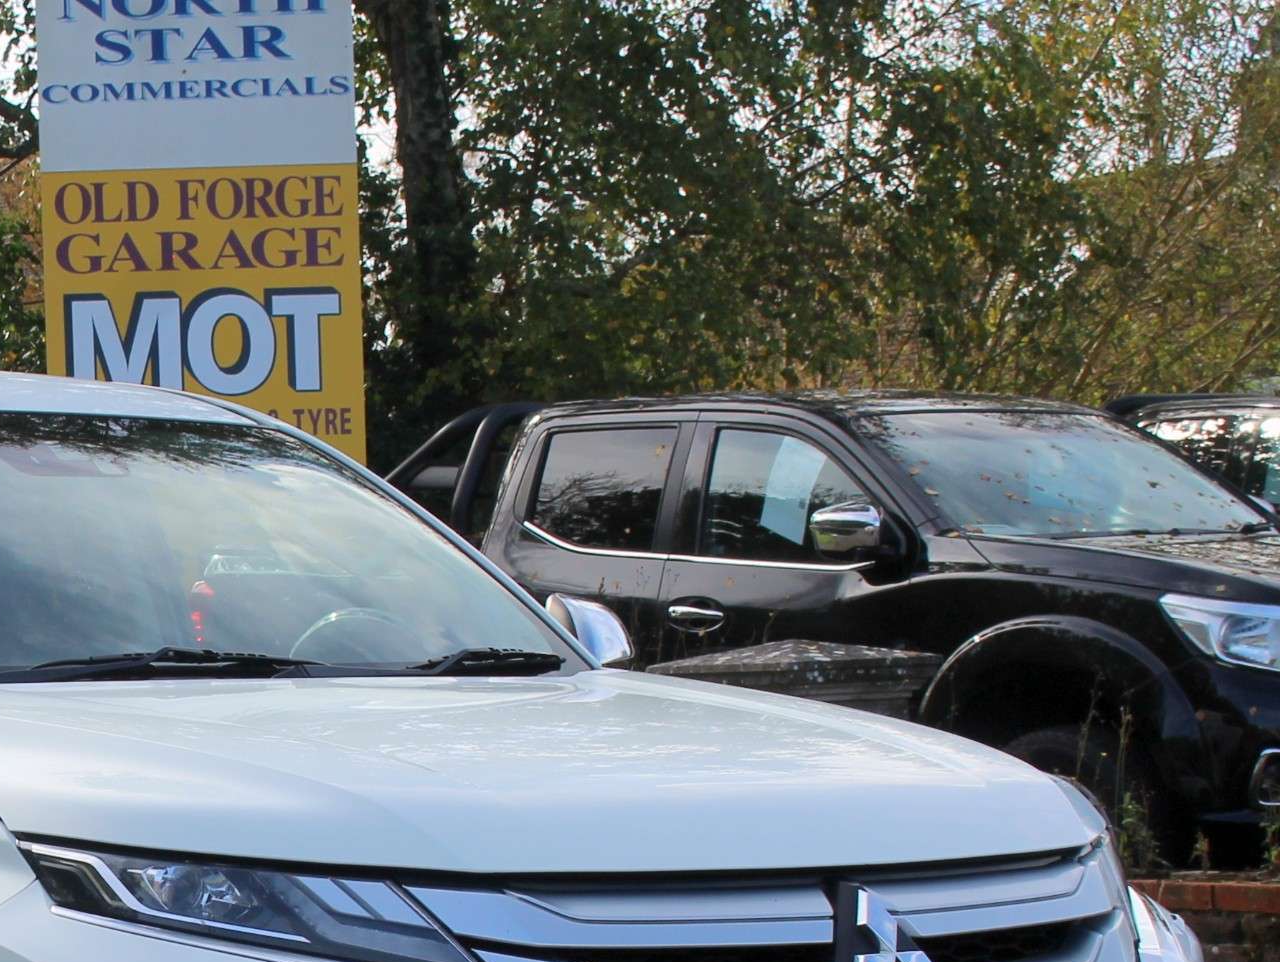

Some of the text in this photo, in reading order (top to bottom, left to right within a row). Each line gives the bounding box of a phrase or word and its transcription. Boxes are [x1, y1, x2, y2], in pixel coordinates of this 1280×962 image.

[95, 25, 293, 65] STAR
[42, 75, 350, 104] COMMERCIALS
[54, 175, 344, 224] OLD FORGE
[55, 227, 345, 274] GARAGE
[63, 286, 341, 396] MOT
[292, 407, 352, 435] TYRE
